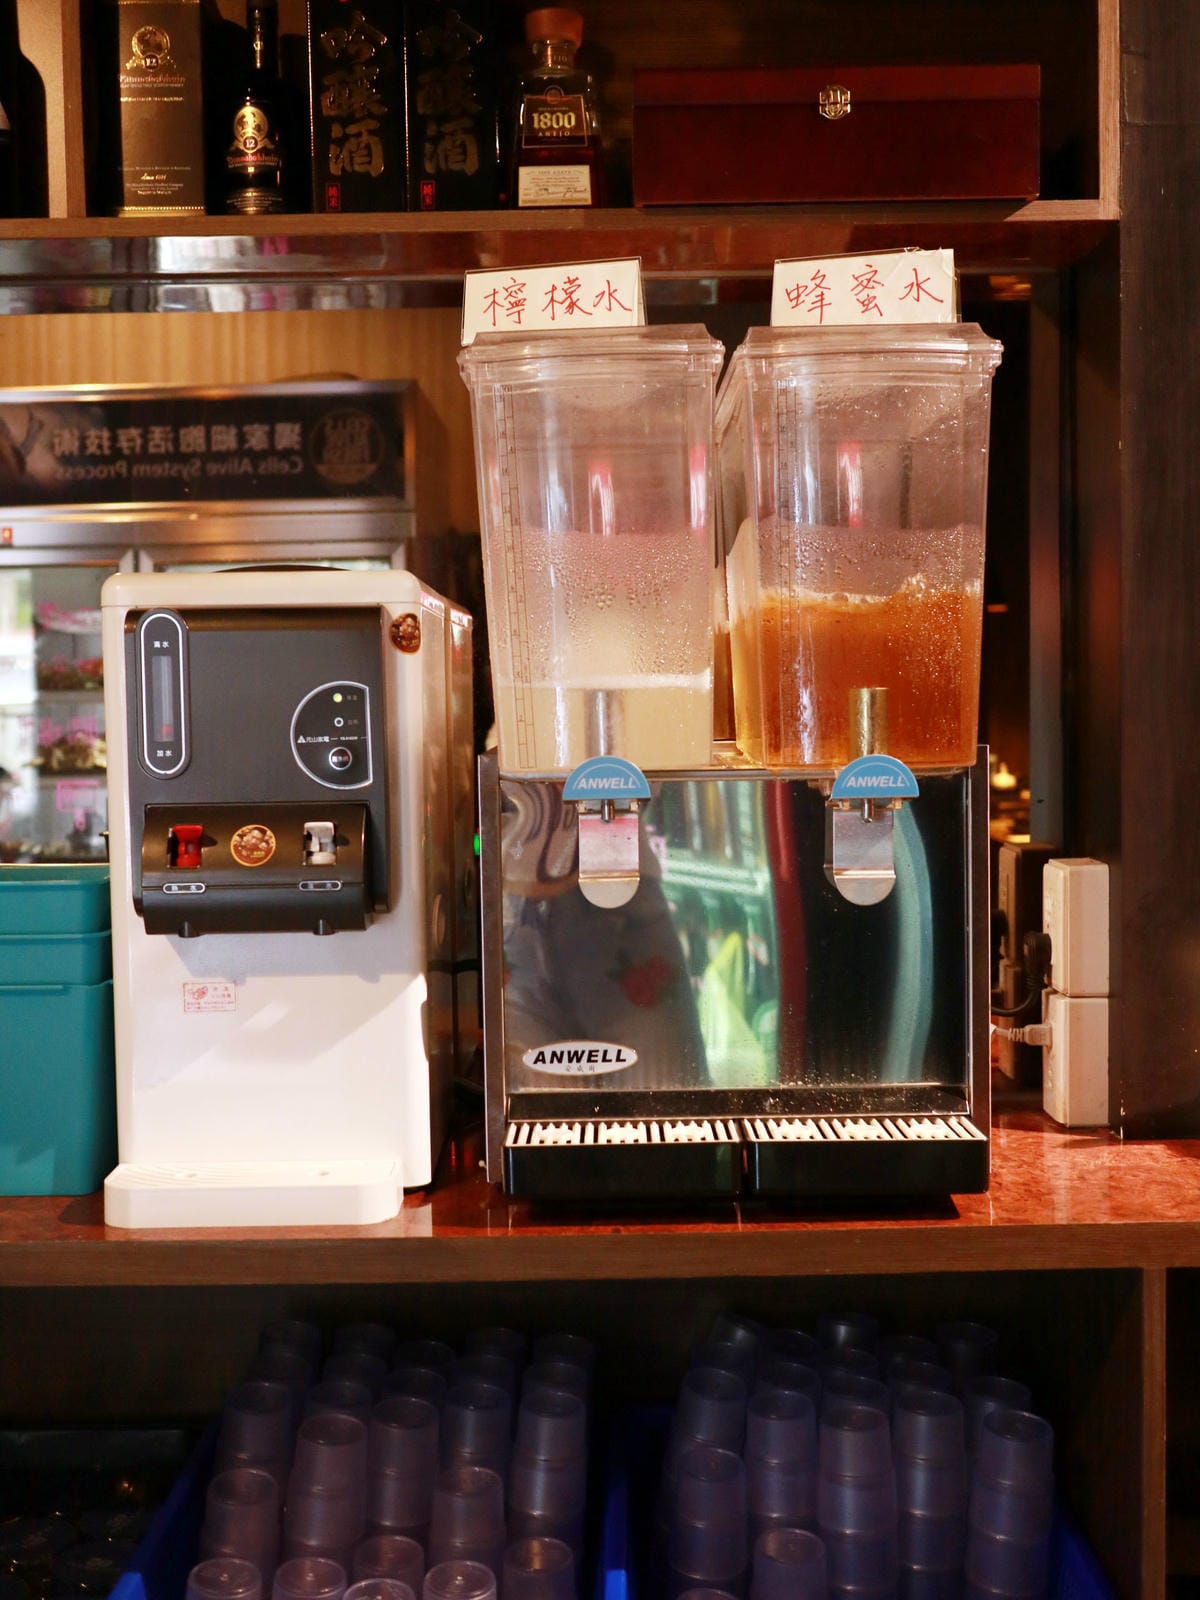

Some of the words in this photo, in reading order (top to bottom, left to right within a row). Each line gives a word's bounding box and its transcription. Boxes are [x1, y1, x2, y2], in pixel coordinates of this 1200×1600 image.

[532, 111, 576, 129] 1800
[245, 139, 256, 148] 12
[483, 275, 634, 327] 檸檬水
[784, 263, 945, 324] 蜂蜜水
[577, 776, 636, 790] ANWELL
[847, 775, 906, 788] ANWELL
[532, 1049, 627, 1065] ANWELL
